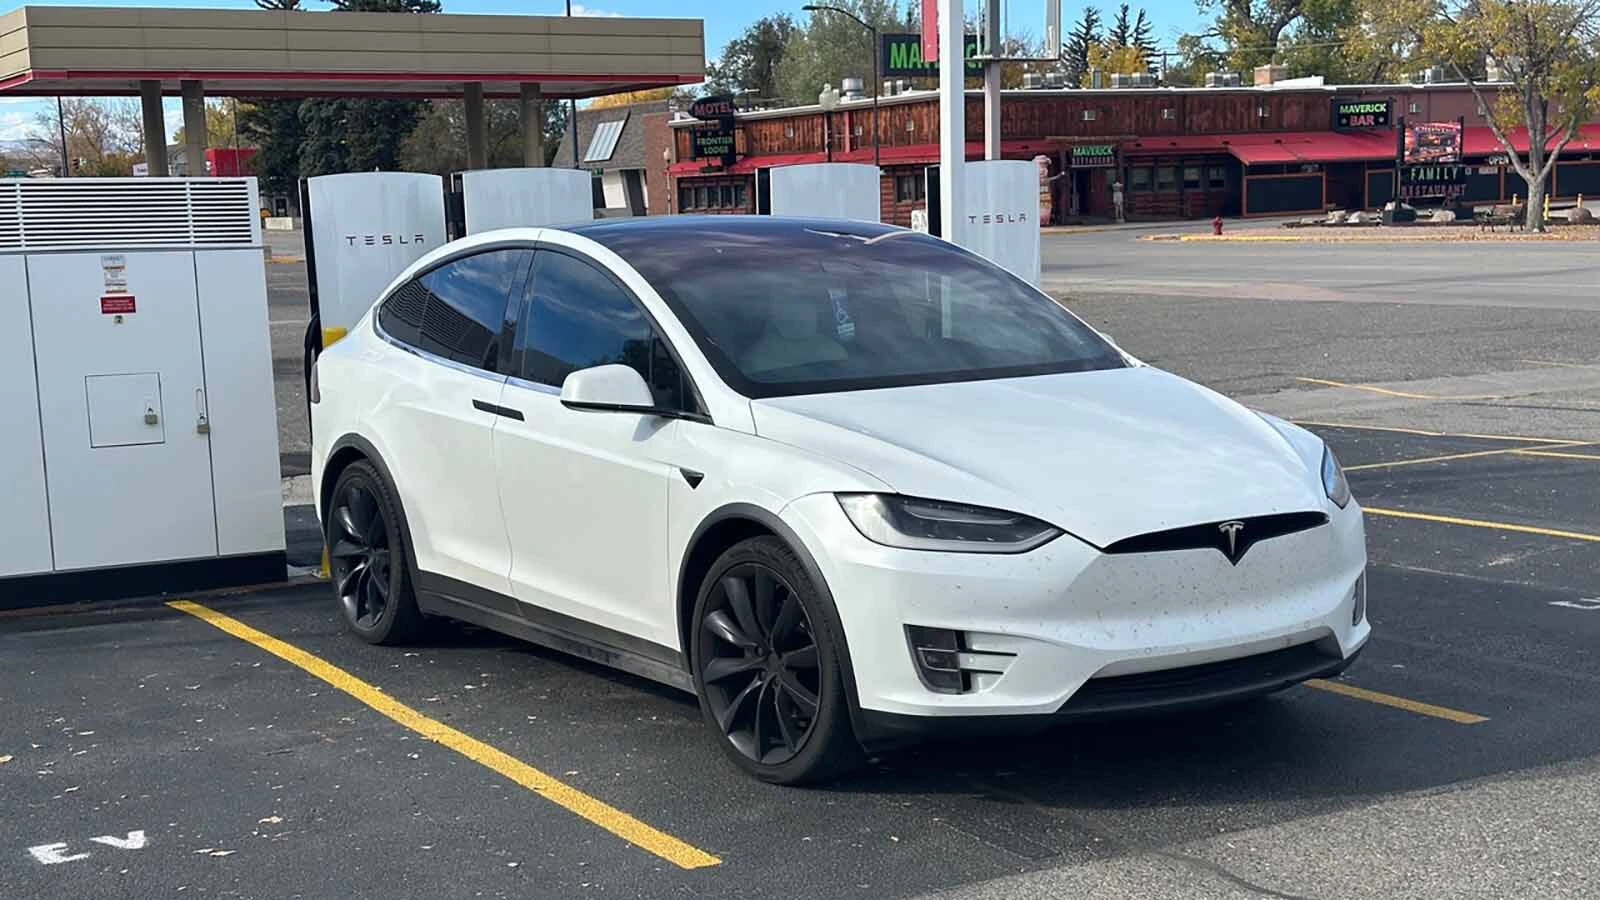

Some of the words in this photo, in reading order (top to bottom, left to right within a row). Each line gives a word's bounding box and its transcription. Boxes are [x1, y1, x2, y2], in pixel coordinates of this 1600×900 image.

[694, 102, 734, 115] MOTEL
[1339, 103, 1387, 114] MAVERICK
[1350, 115, 1375, 127] BAR
[703, 145, 729, 155] LODGE
[1410, 167, 1458, 181] FAMILY
[1401, 184, 1467, 197] RESTAURANT
[968, 213, 1026, 225] TESLA
[345, 234, 425, 246] TESLA
[27, 829, 146, 865] EV
